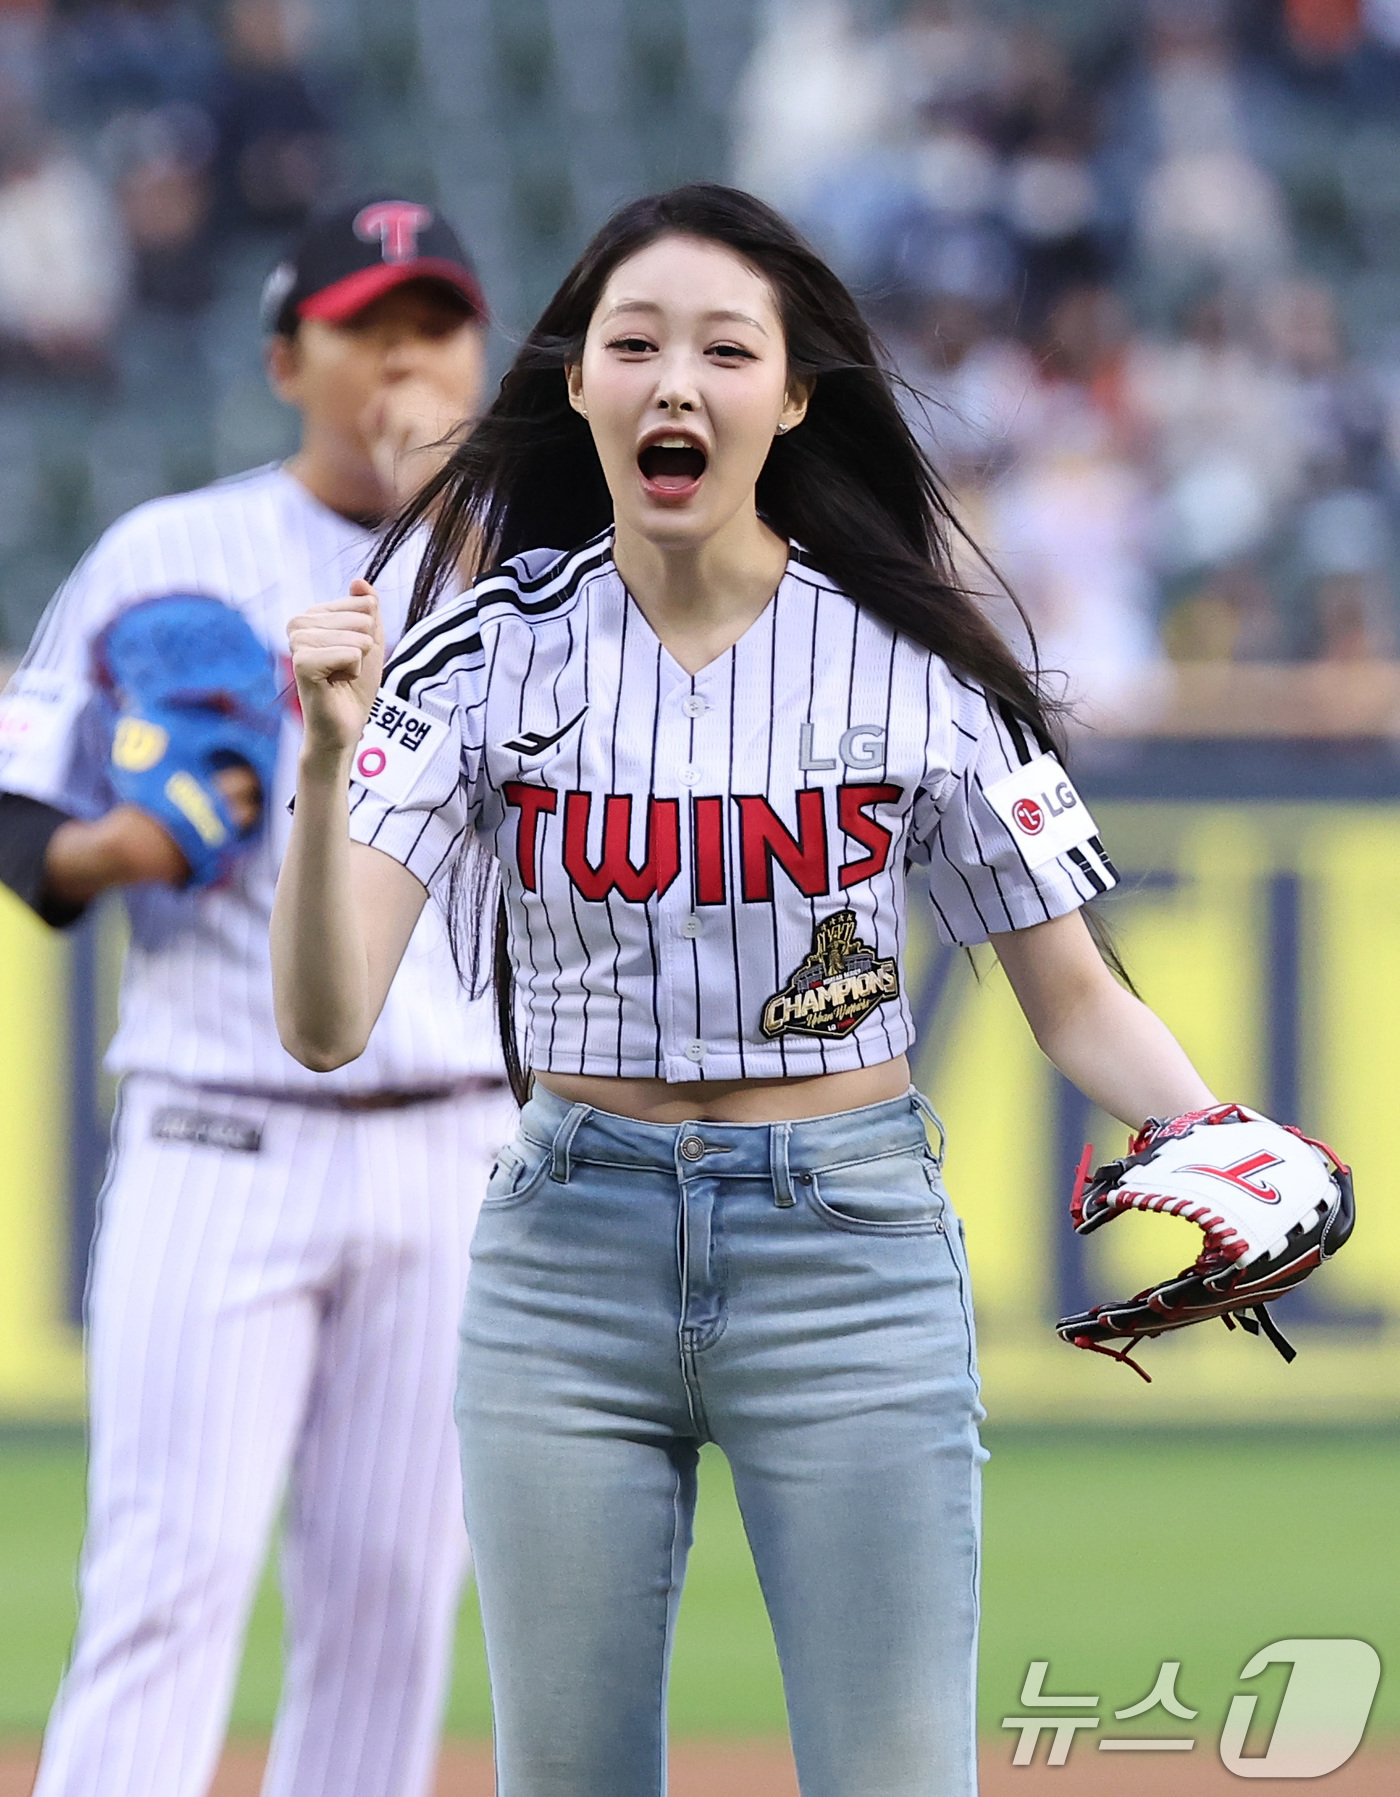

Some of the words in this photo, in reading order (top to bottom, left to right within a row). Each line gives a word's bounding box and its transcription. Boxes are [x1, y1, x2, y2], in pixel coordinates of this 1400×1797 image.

[799, 723, 886, 771] LG
[1041, 782, 1077, 818] LG
[501, 781, 904, 906] TWINS
[765, 962, 896, 1031] CHAMPIONS
